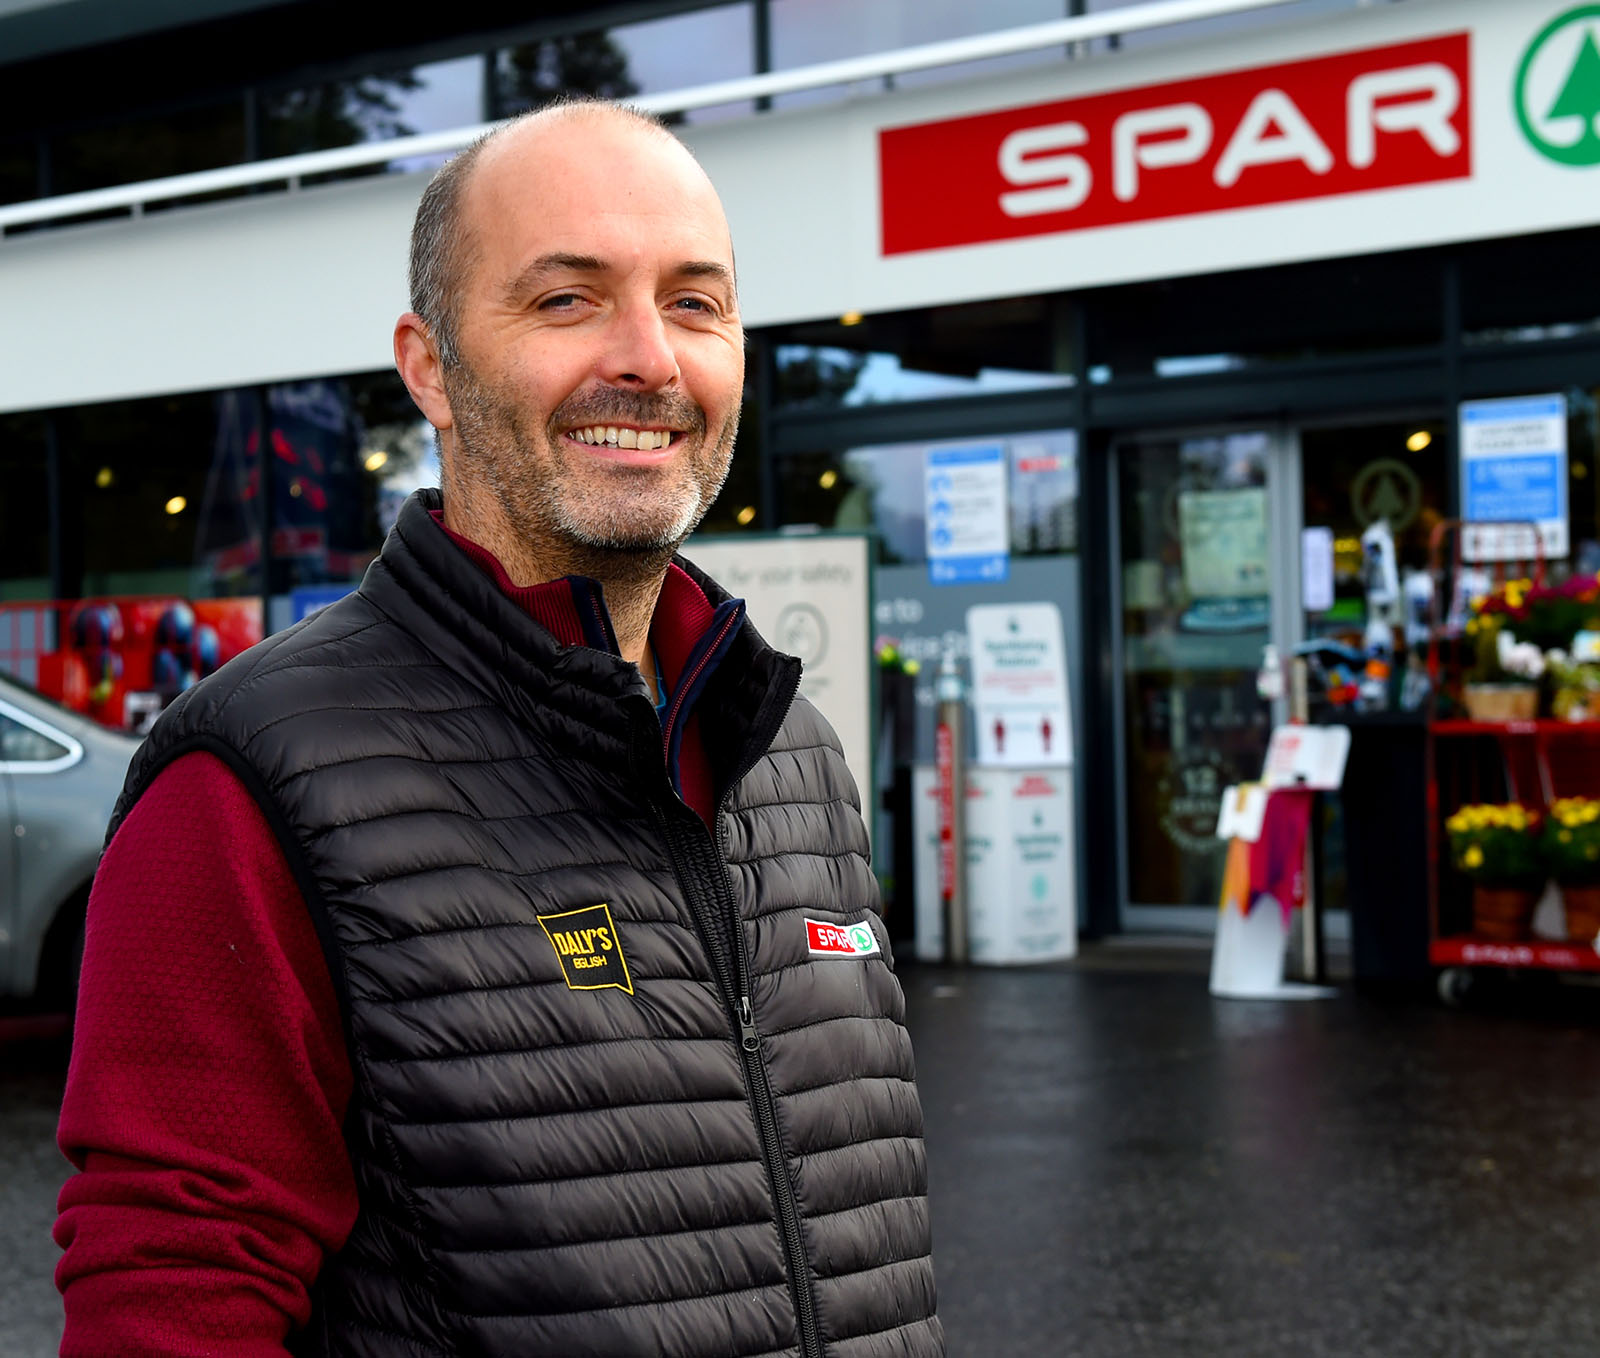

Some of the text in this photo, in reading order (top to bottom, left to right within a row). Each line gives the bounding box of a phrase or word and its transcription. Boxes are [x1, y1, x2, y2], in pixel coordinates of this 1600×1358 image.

[998, 62, 1461, 218] SPAR
[552, 926, 613, 956] DALY'S
[816, 928, 853, 949] SPAR
[572, 954, 608, 970] EGLISH
